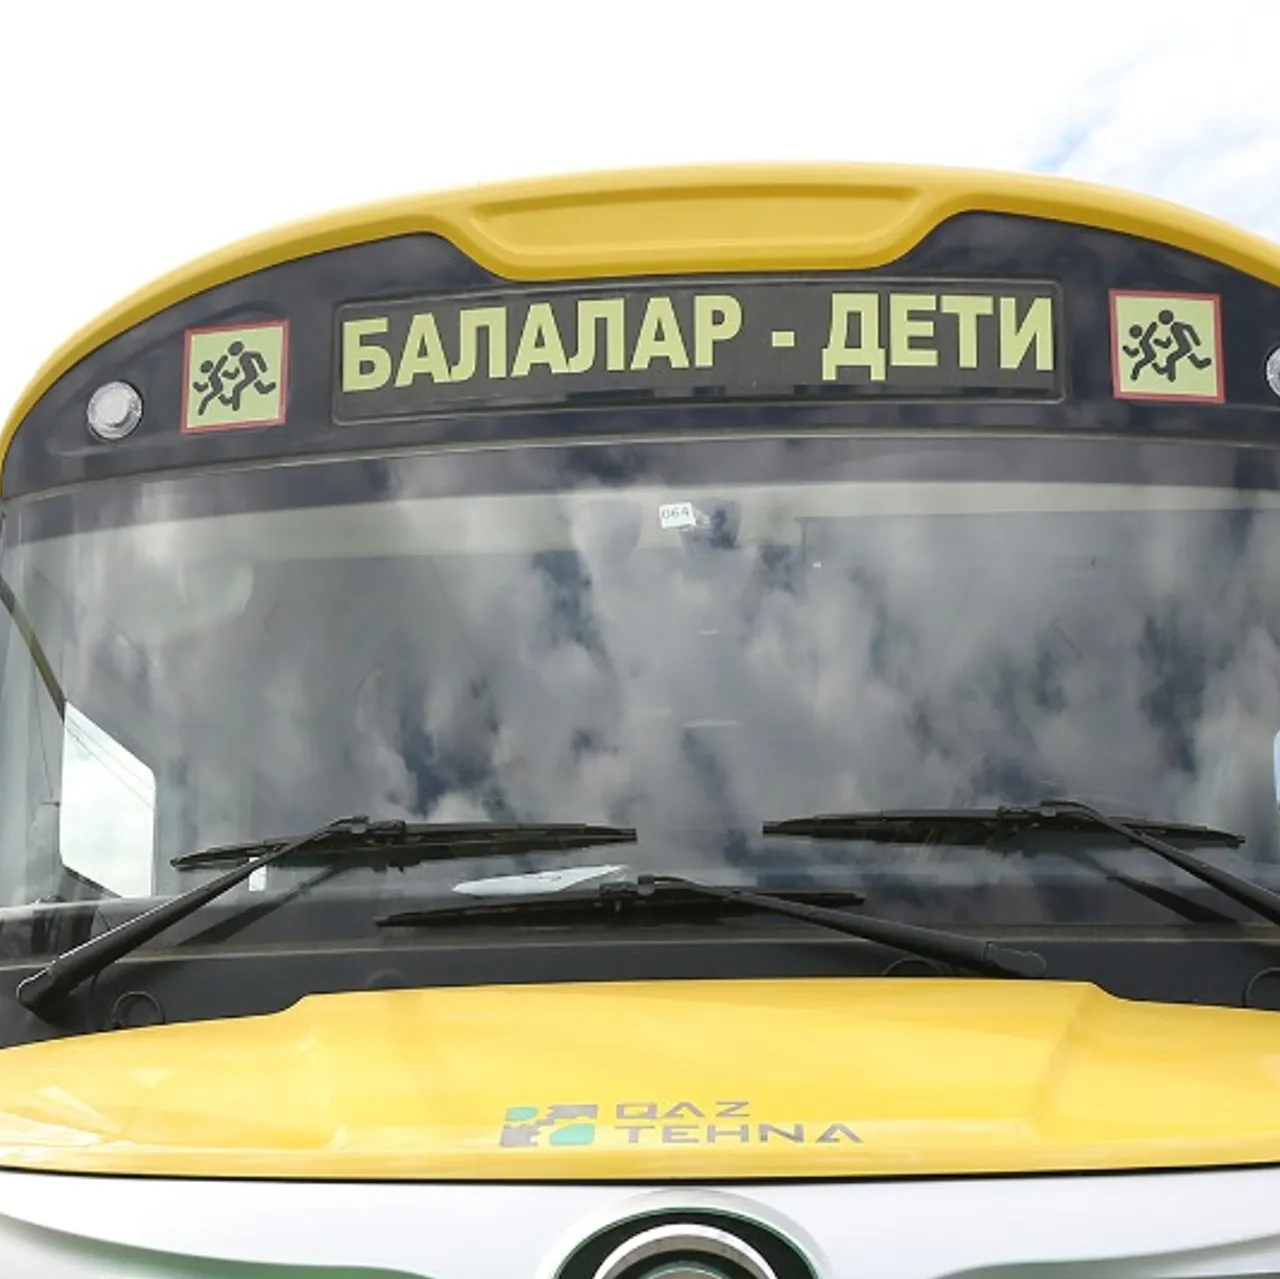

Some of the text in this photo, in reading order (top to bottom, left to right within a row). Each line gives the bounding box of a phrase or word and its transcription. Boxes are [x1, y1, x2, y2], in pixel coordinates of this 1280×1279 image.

[342, 293, 1054, 392] БАЛАЛАР - ДЕТИ
[616, 1101, 750, 1120] QAZ
[614, 1123, 863, 1144] TEHNA
